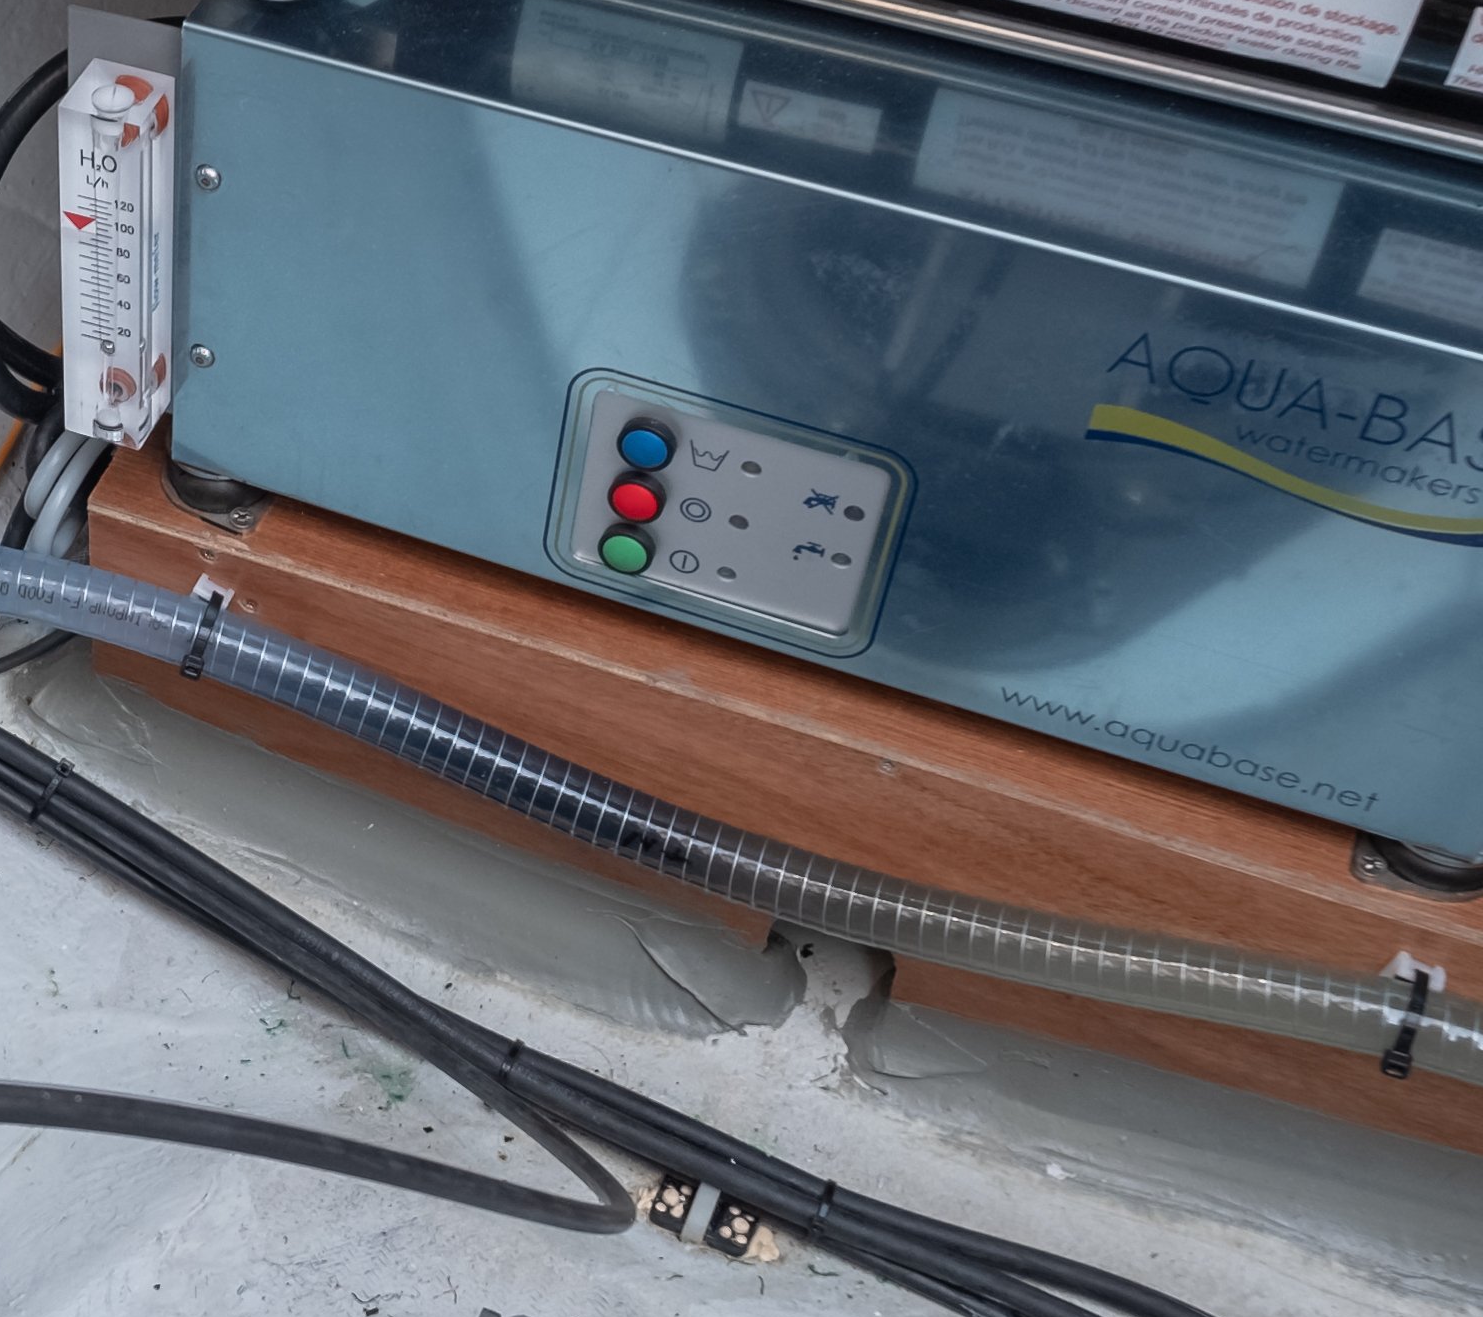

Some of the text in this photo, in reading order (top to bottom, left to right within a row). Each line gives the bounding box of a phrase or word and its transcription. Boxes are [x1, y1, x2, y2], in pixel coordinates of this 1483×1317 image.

[1198, 14, 1294, 45] preservative
[1252, 9, 1272, 25] de
[1273, 14, 1367, 48] production.
[1298, 2, 1320, 18] de
[1322, 7, 1402, 41] stockage.
[114, 200, 134, 212] 120
[114, 221, 135, 237] 100
[116, 247, 130, 258] 80
[116, 273, 130, 283] 60
[117, 299, 130, 309] 40
[117, 326, 130, 337] 20
[1234, 421, 1483, 507] watermakers
[17, 583, 53, 603] FOOD
[1003, 686, 1380, 813] www.aquabase.net
